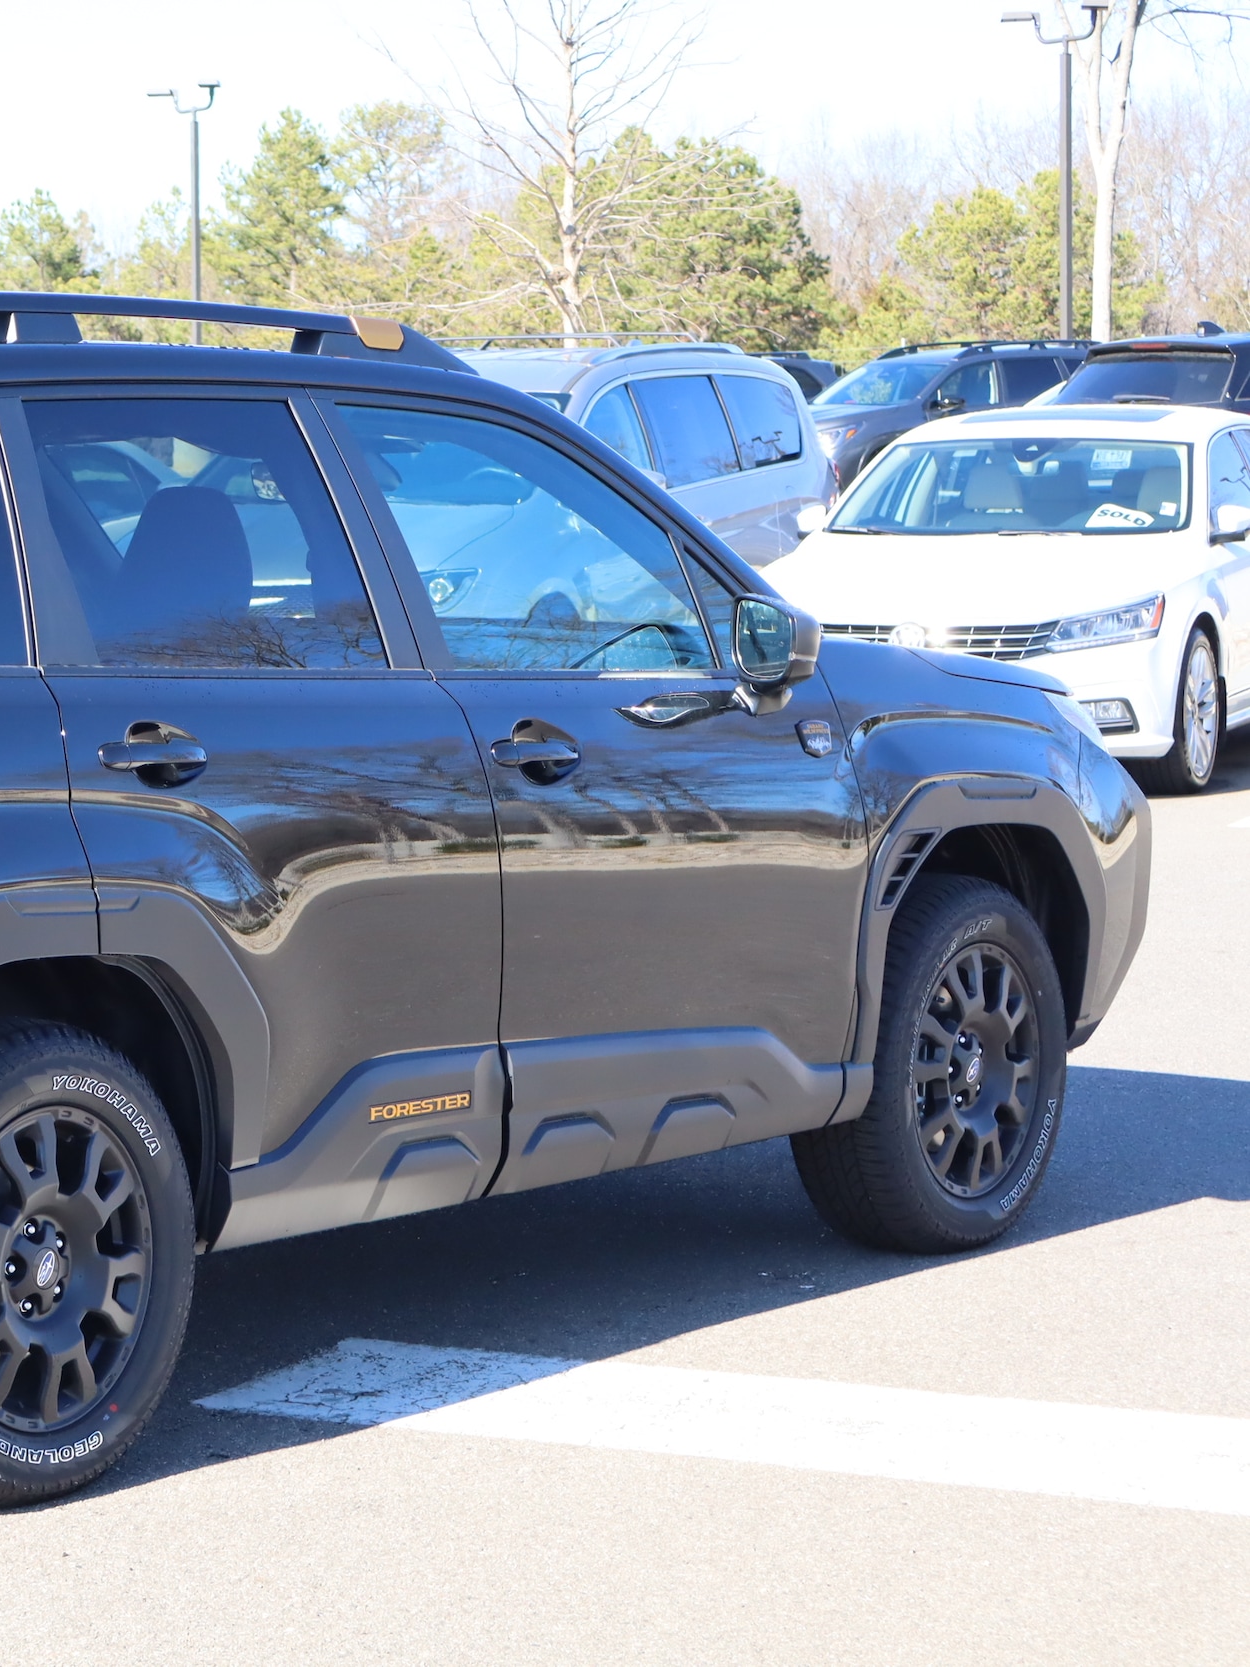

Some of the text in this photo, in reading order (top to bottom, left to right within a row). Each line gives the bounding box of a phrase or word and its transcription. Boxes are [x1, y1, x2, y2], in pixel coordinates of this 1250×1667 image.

[1097, 508, 1146, 526] SOLD
[964, 919, 993, 939] A/T
[52, 1074, 162, 1156] YOKOHAMA
[370, 1092, 471, 1121] FORESTER
[999, 1098, 1057, 1211] YOKOHAMA
